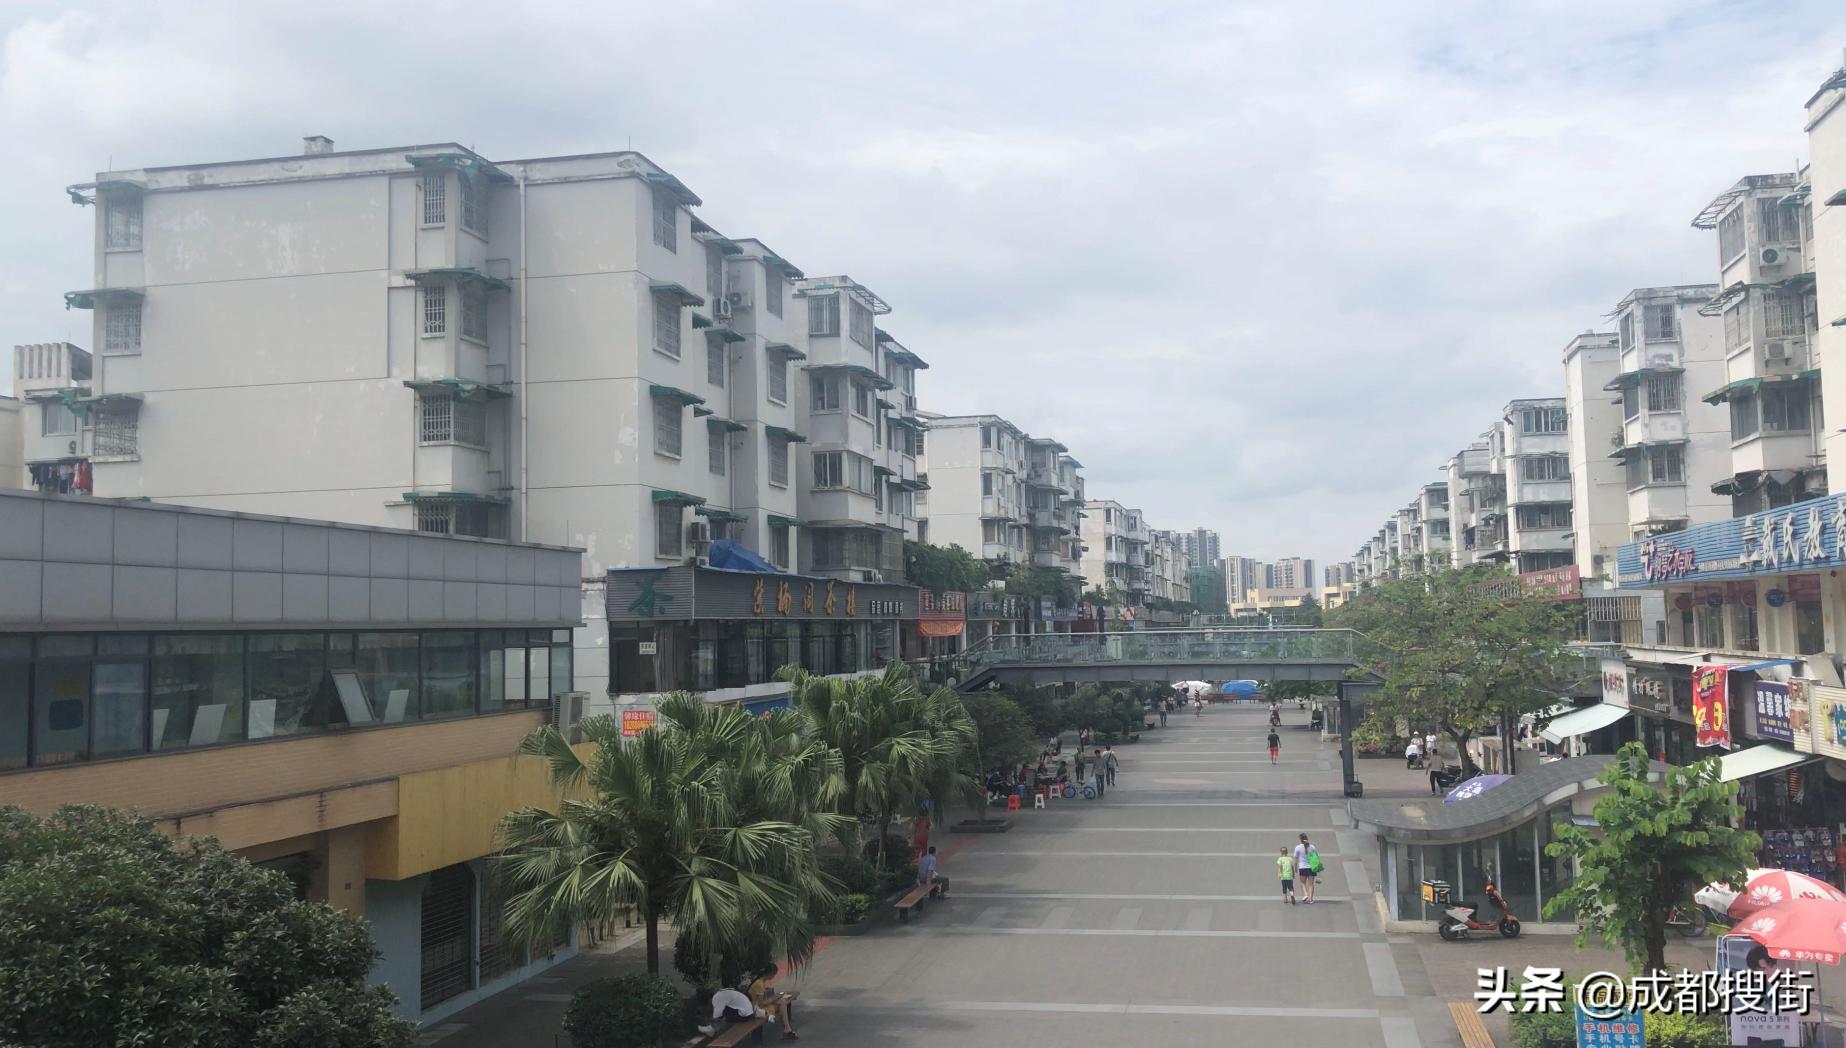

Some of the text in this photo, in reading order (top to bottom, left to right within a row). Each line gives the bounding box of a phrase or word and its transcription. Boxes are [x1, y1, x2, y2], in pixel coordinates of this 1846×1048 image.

[628, 575, 674, 619] 茶
[1795, 950, 1834, 962] 华为专卖
[1740, 1015, 1767, 1023] nova
[1769, 1015, 1774, 1023] 5
[1583, 1022, 1639, 1034] 手机维修
